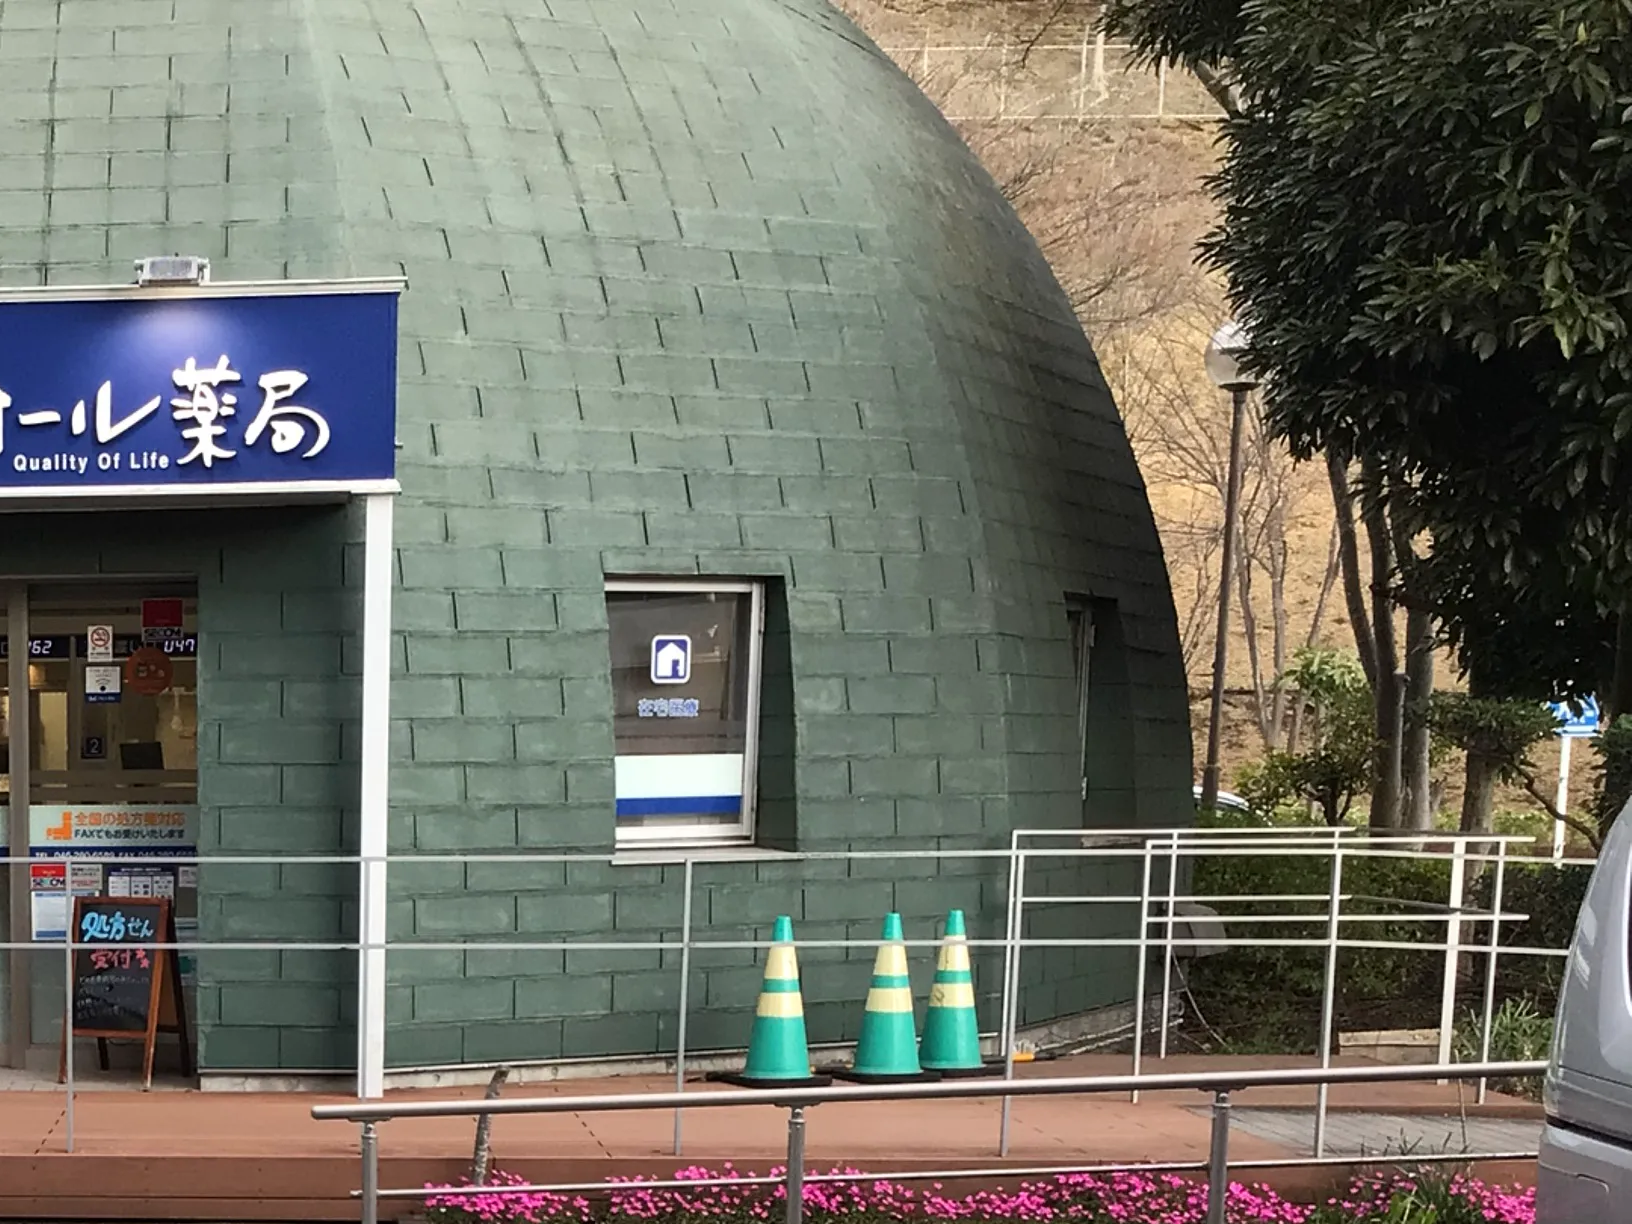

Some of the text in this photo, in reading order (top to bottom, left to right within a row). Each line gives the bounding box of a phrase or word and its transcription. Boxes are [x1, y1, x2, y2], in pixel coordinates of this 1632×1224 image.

[13, 452, 169, 474] Quality Of Life
[28, 640, 52, 654] 62
[89, 740, 100, 754] 2
[74, 829, 185, 840] FAXでもお受けいたします
[81, 911, 154, 942] 処方せん
[90, 948, 131, 969] 受付
